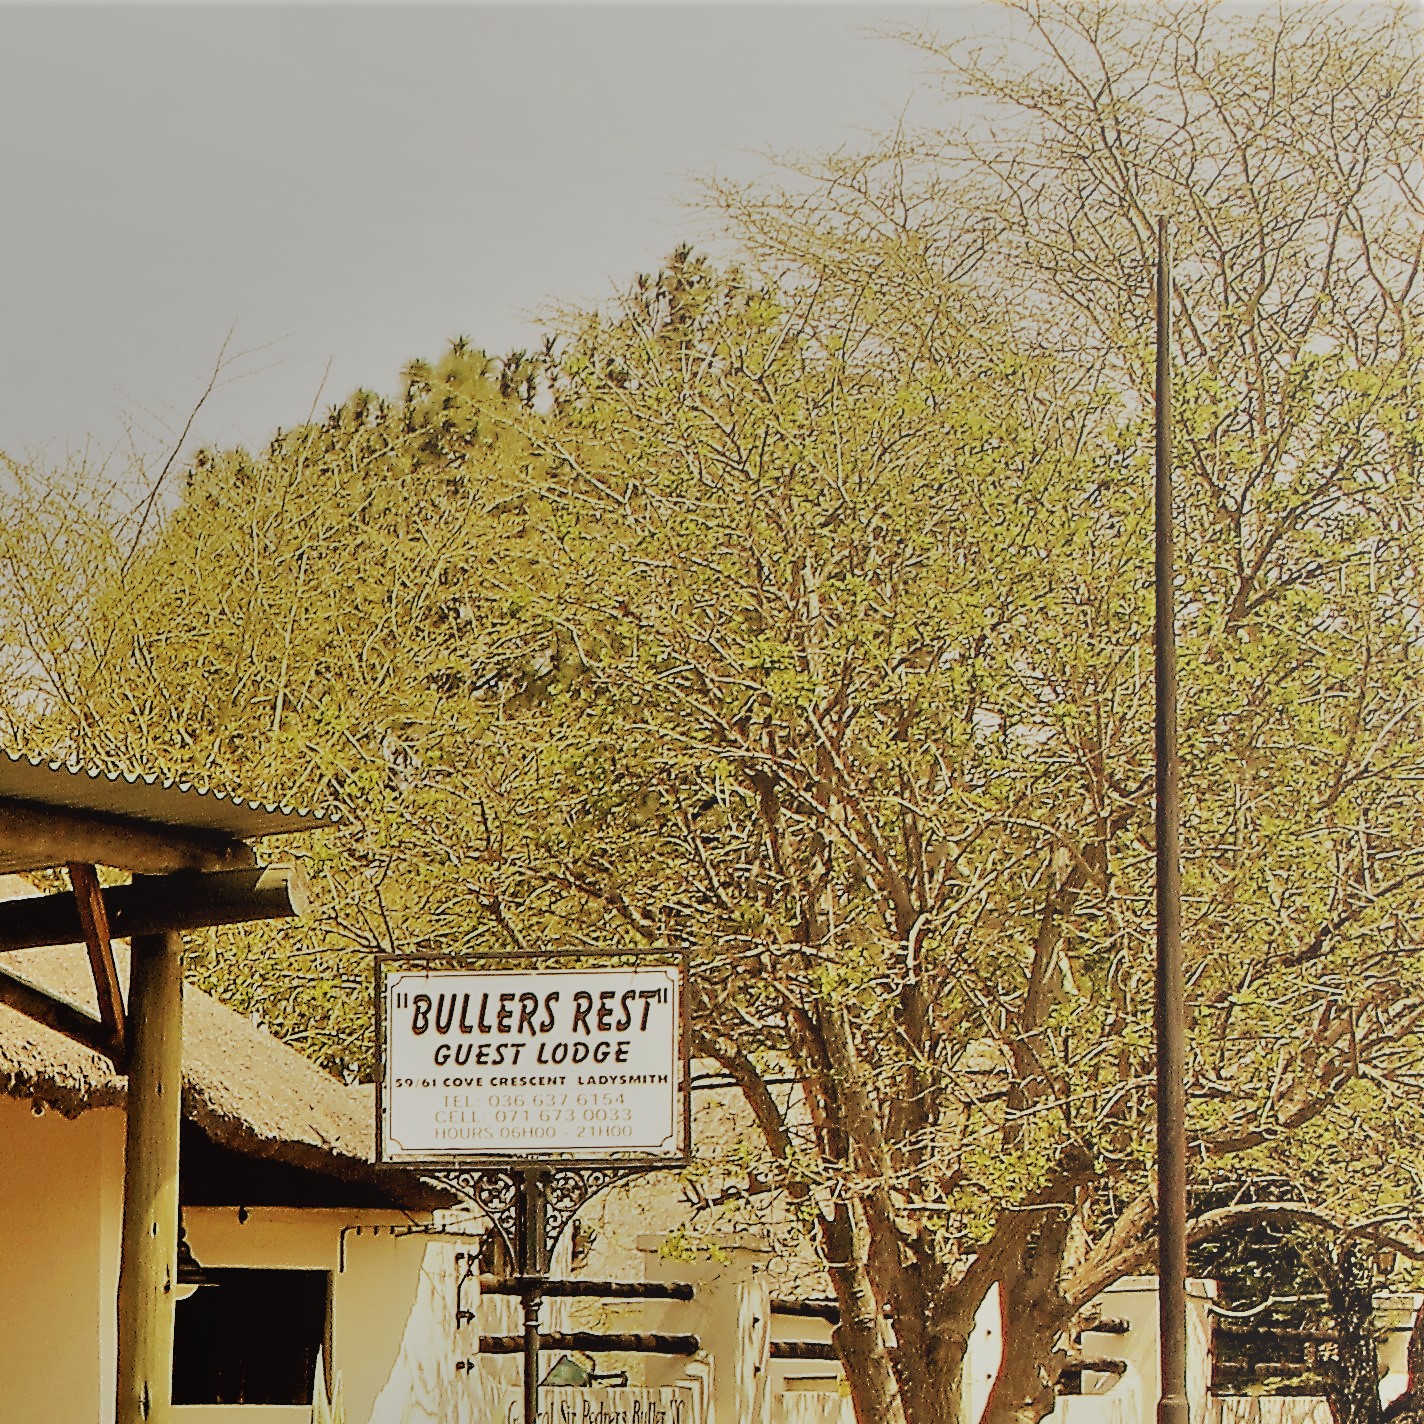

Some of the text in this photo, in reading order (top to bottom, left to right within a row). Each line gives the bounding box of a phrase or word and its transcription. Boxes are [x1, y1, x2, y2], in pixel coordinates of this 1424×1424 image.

[396, 987, 668, 1037] "BULLERS REST"
[434, 1041, 631, 1066] GUEST LODGE
[395, 1074, 669, 1088] 59/61 COVE CRESCENT LADYSMITH
[488, 1094, 525, 1107] 036
[533, 1093, 568, 1107] 637
[576, 1093, 625, 1106] 6154
[495, 1110, 529, 1123] 071
[539, 1109, 575, 1122] 673
[583, 1108, 632, 1122] 0033
[434, 1127, 494, 1139] HOURS
[500, 1126, 556, 1139] 06H00
[577, 1125, 632, 1138] 21H00
